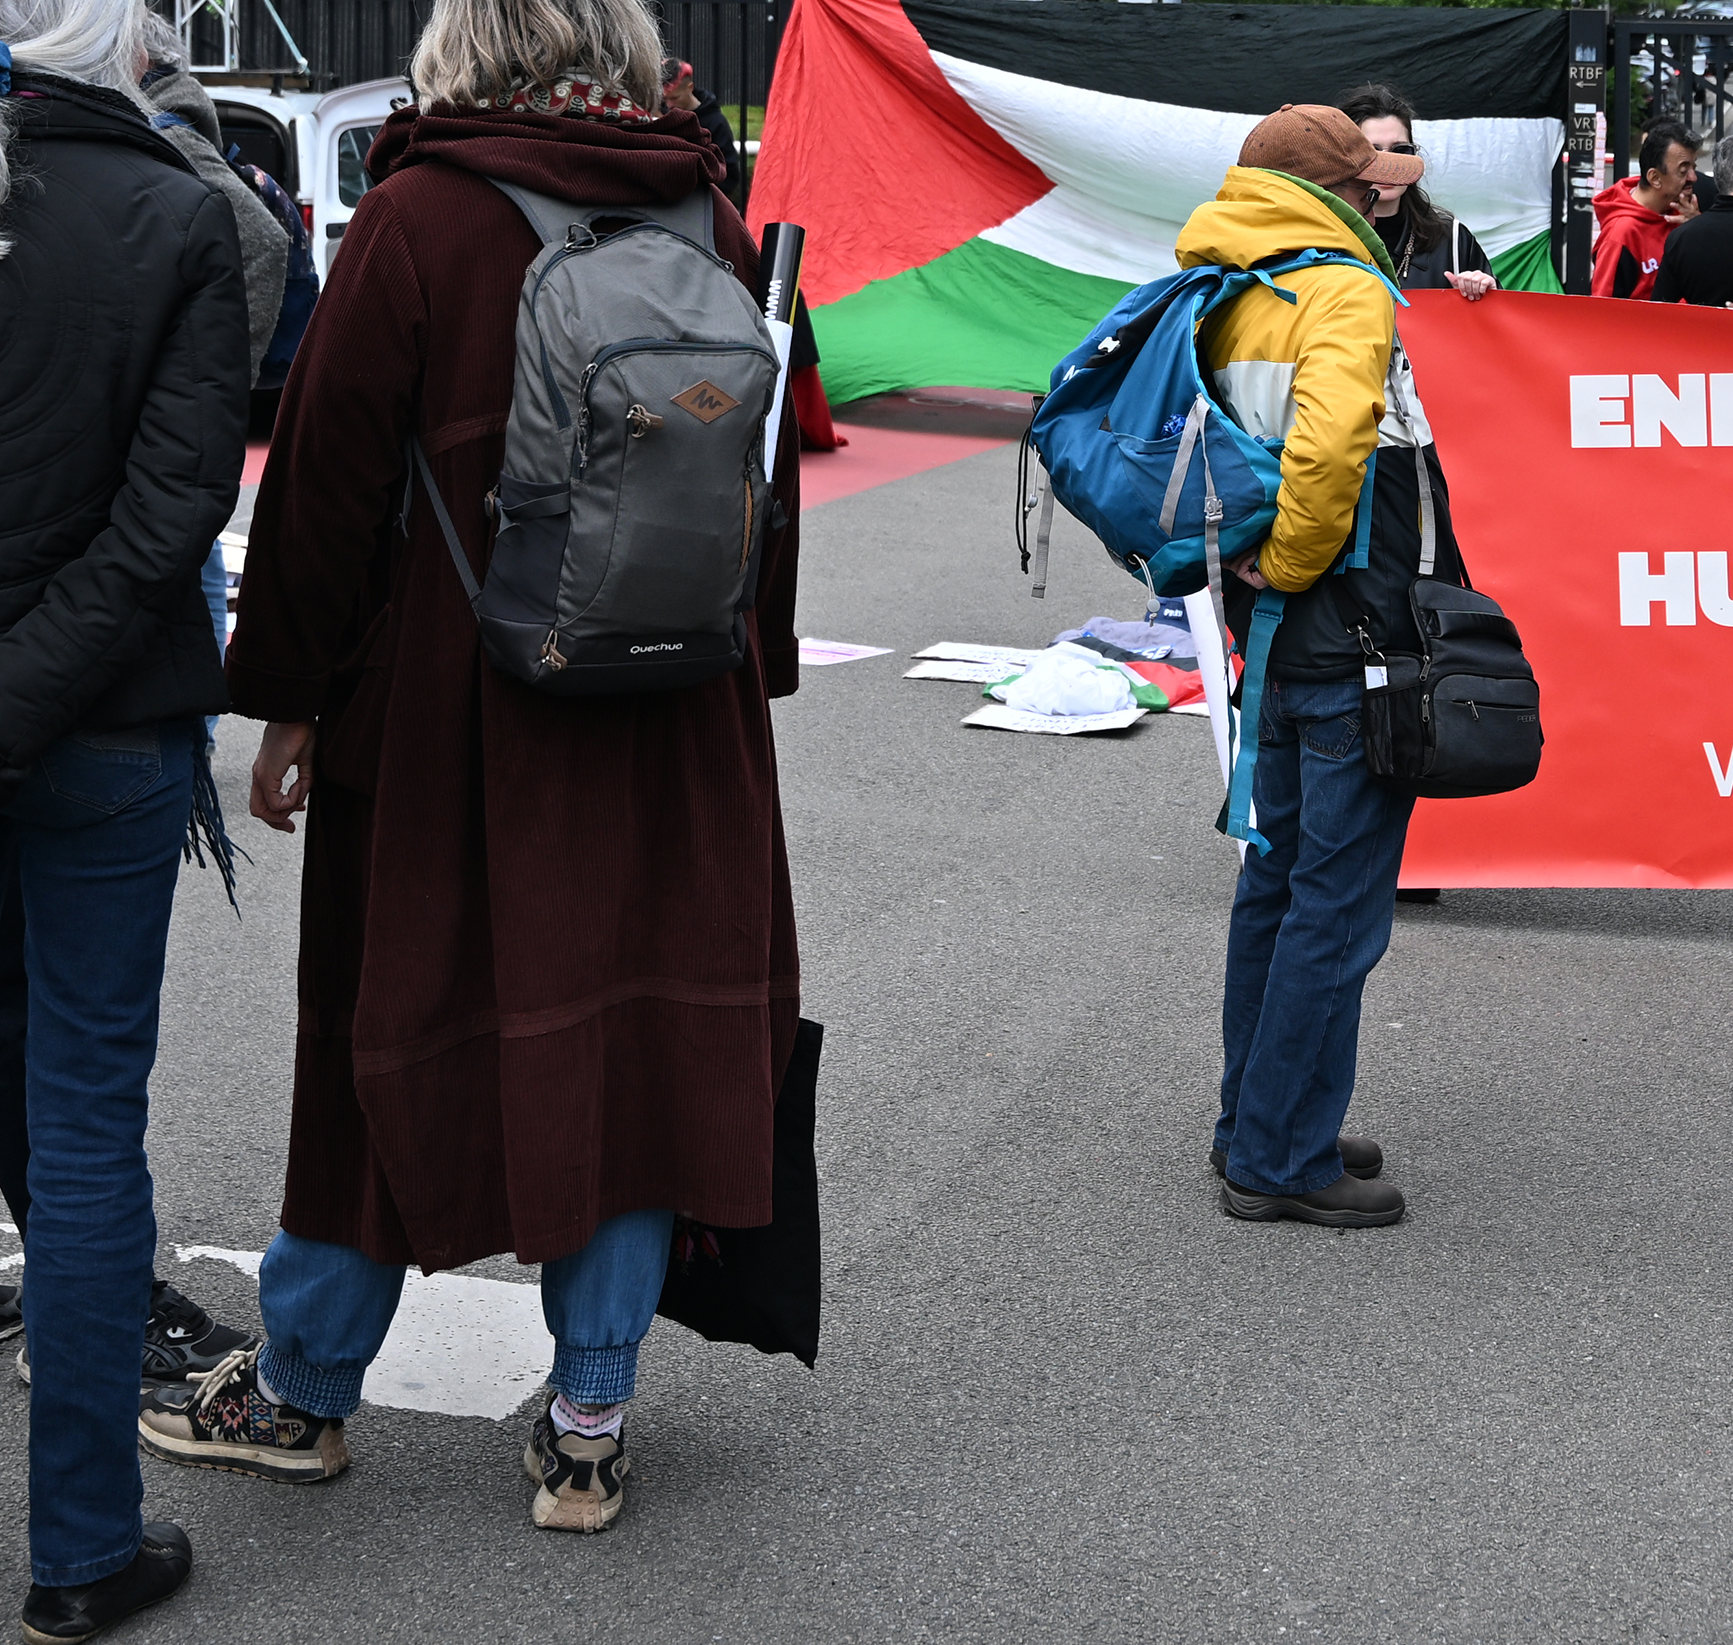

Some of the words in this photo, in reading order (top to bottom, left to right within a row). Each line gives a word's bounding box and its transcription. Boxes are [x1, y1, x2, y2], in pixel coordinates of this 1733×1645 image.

[1569, 66, 1604, 80] RTBF
[1568, 138, 1594, 151] RTB
[629, 642, 684, 655] Quechua
